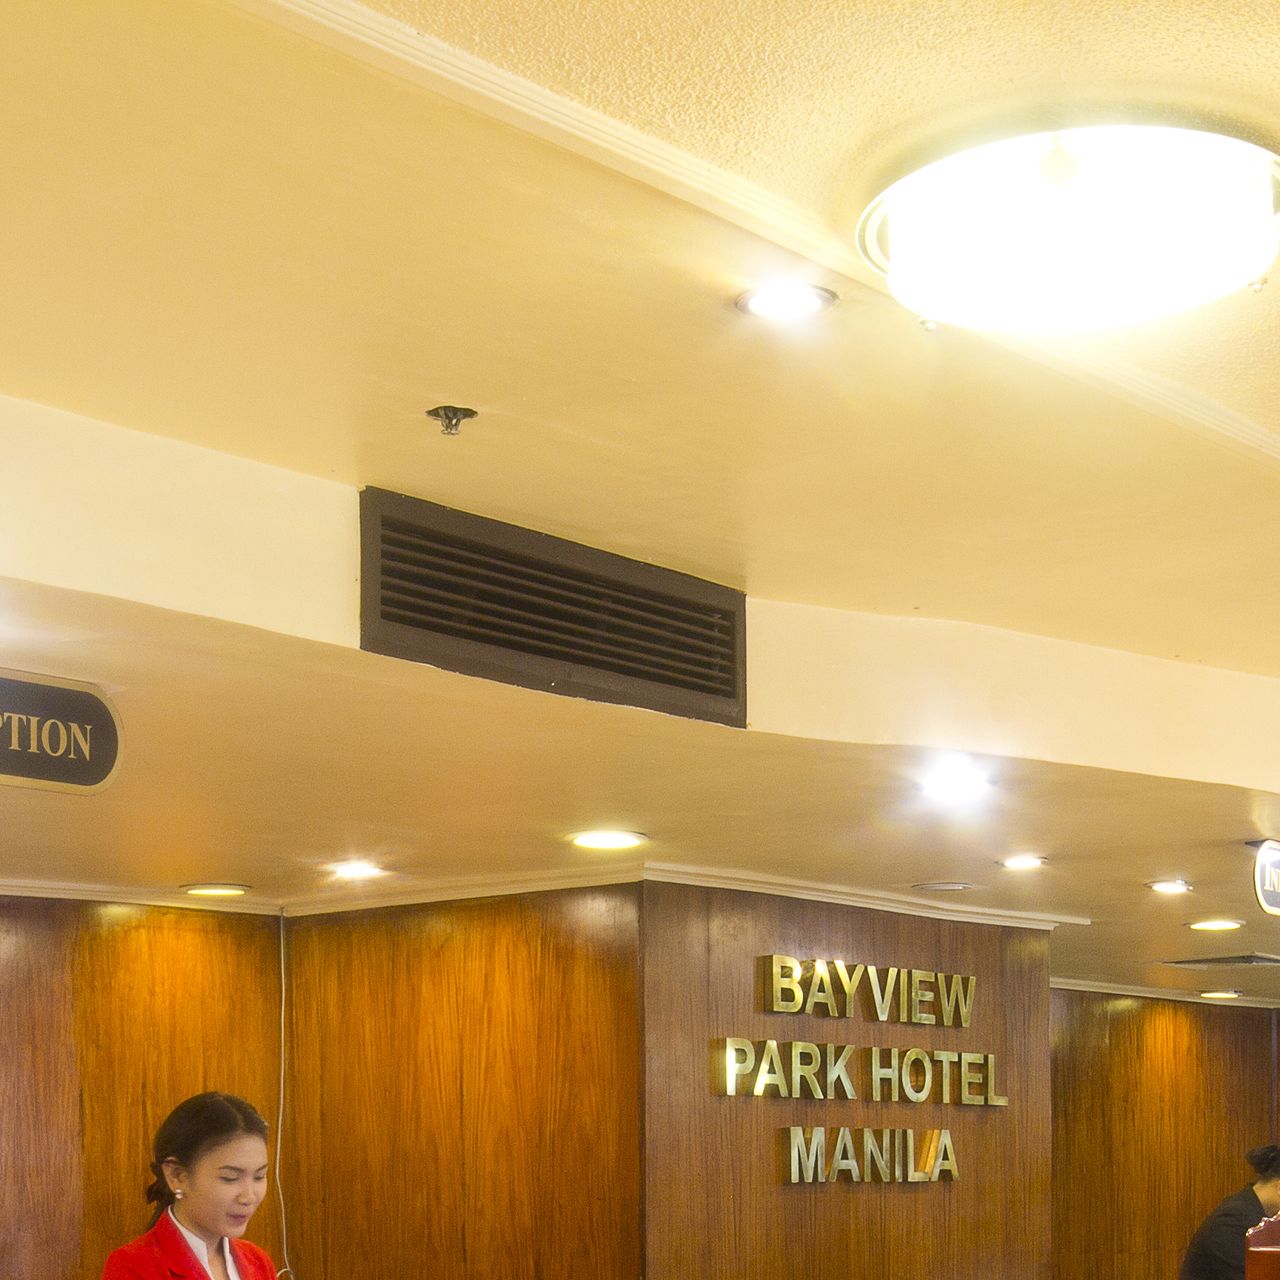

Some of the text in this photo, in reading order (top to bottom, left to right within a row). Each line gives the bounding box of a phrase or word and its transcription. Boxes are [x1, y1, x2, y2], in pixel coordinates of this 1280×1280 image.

[770, 954, 977, 1028] BAYVIEW
[724, 1037, 1010, 1107] PARK HOTEL
[789, 1126, 960, 1184] MANILA
